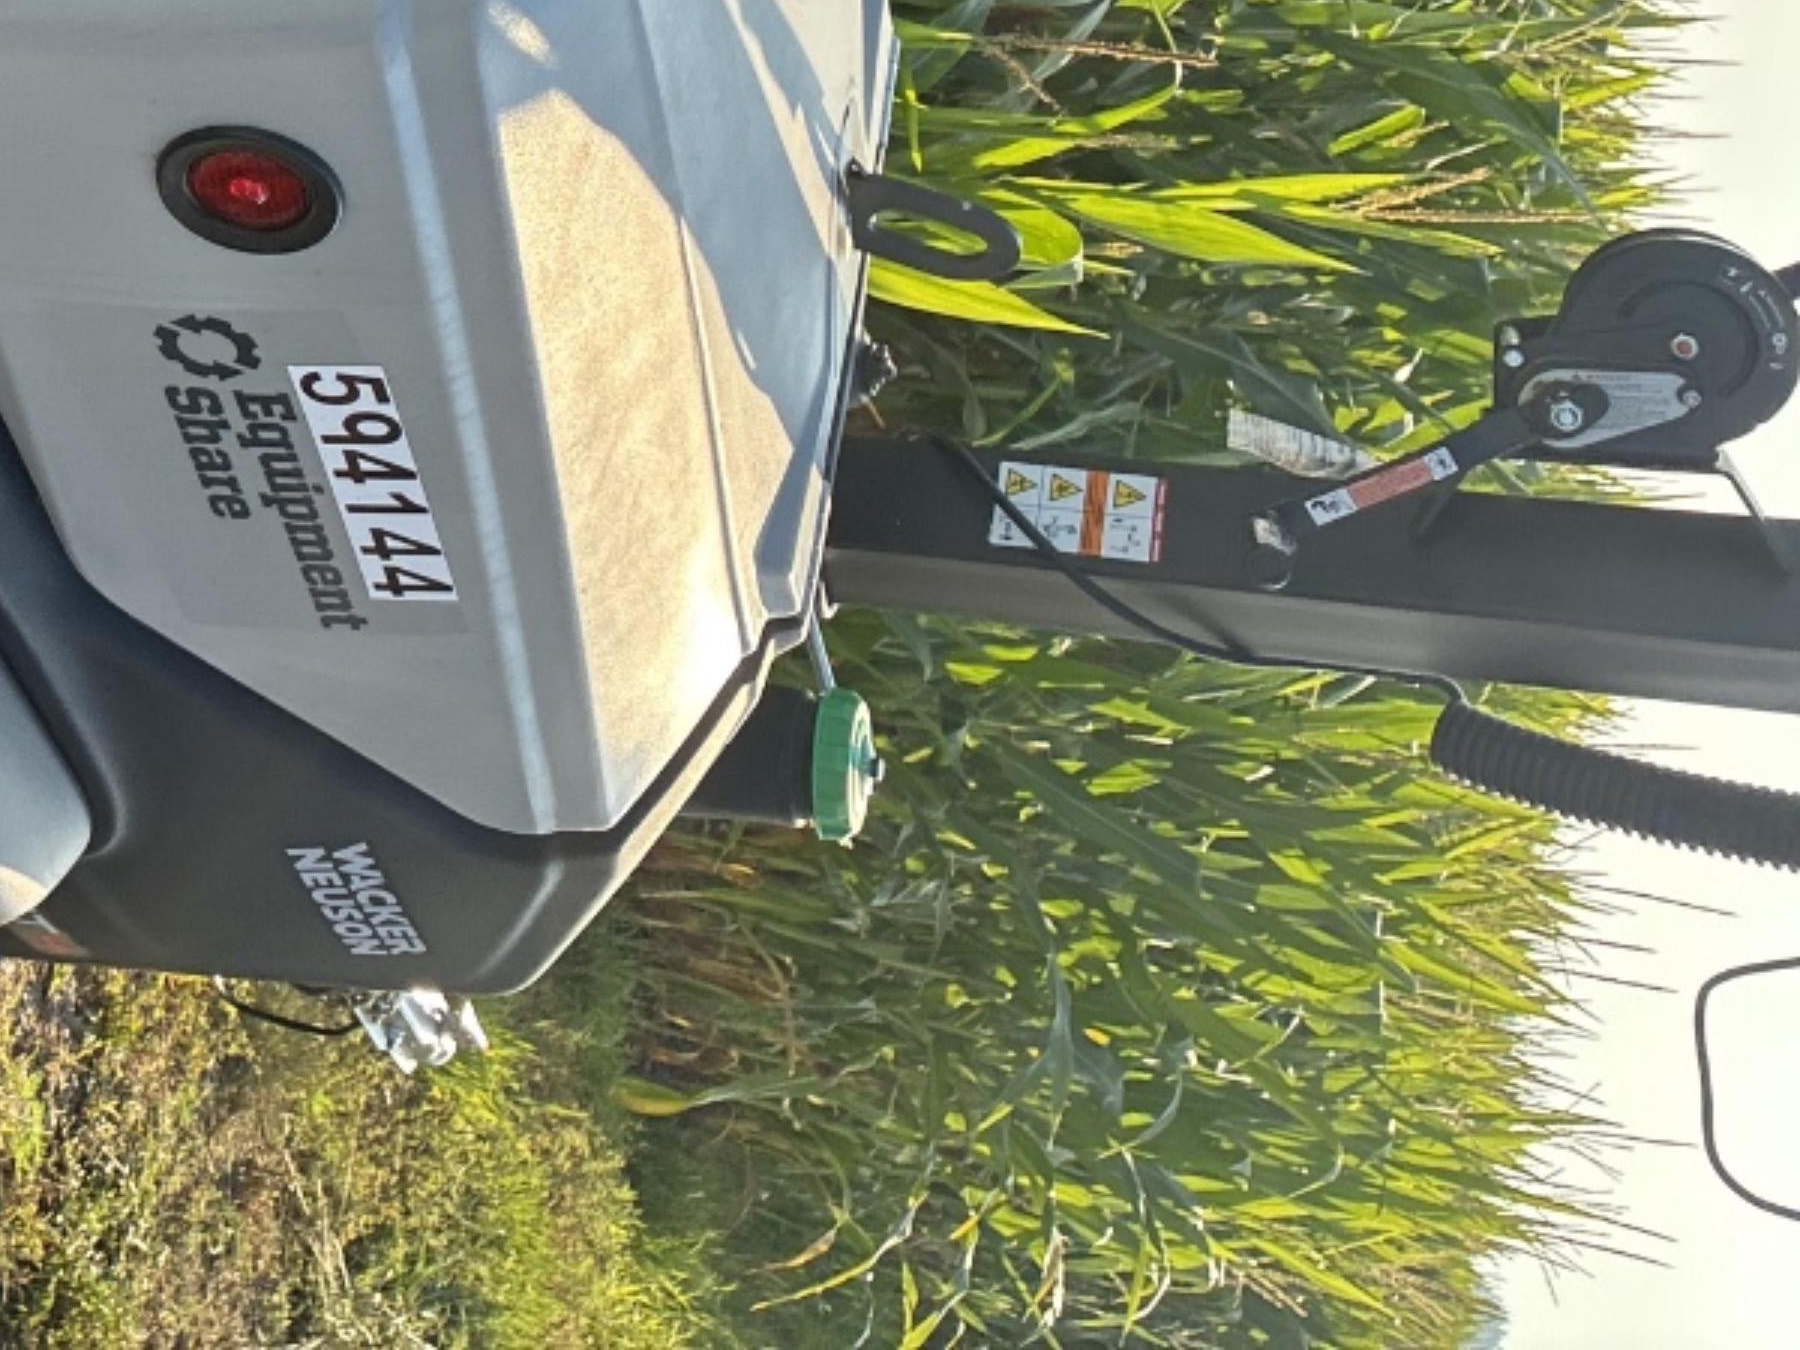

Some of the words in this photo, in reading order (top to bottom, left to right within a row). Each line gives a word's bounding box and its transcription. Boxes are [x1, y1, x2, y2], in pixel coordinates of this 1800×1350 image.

[163, 385, 252, 520] Share
[231, 389, 370, 631] Equipment
[299, 371, 454, 597] 594144
[284, 846, 388, 956] NEUSON
[331, 841, 428, 956] WACKER
